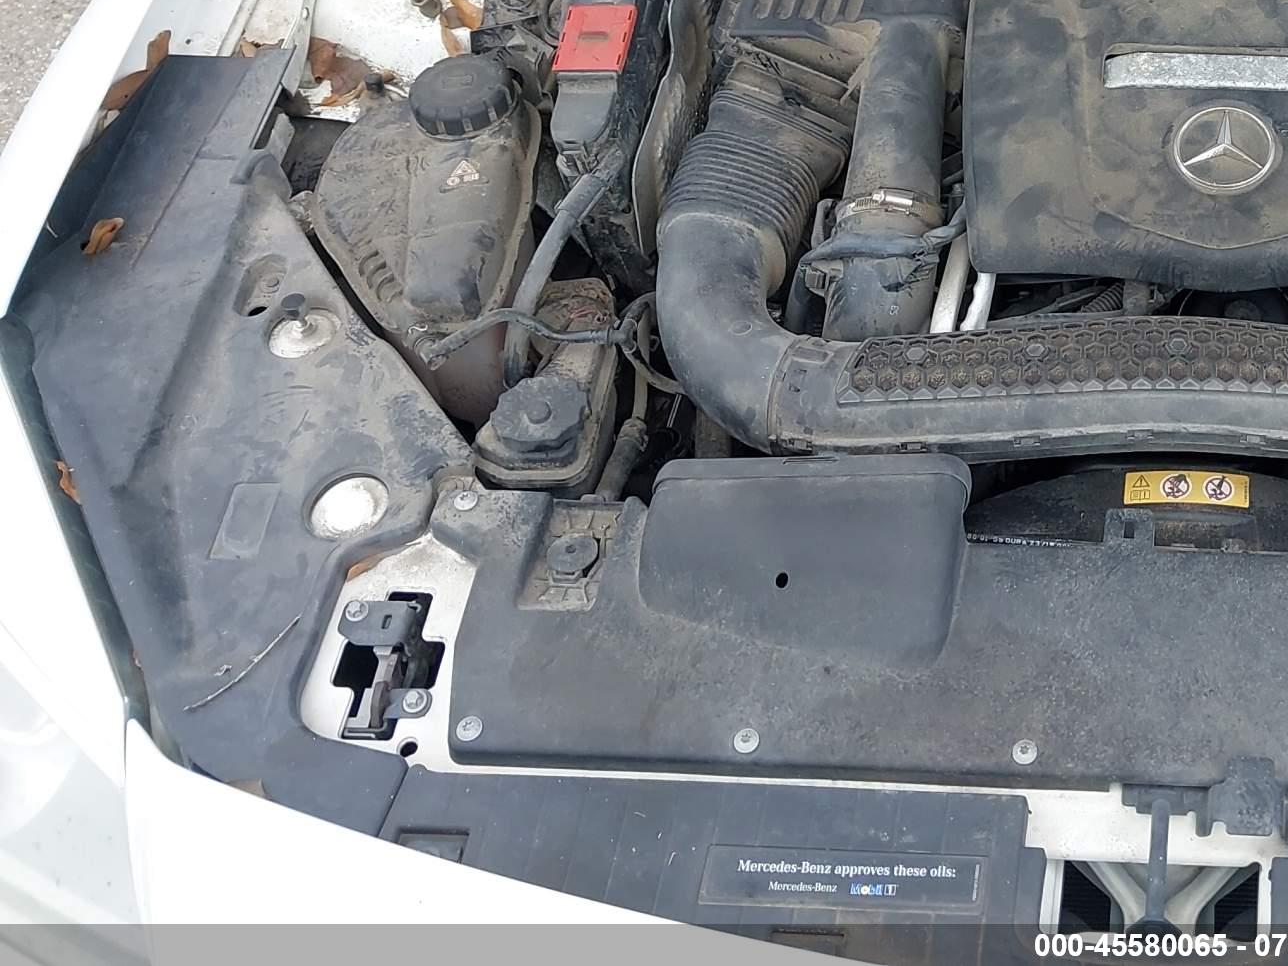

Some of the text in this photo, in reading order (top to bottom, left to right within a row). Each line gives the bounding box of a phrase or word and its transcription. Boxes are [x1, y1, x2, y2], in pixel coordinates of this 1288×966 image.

[737, 859, 956, 878] Mercedes-Benz approves these oils:
[768, 881, 838, 893] Mercedes-Benz
[850, 883, 884, 895] Mobil
